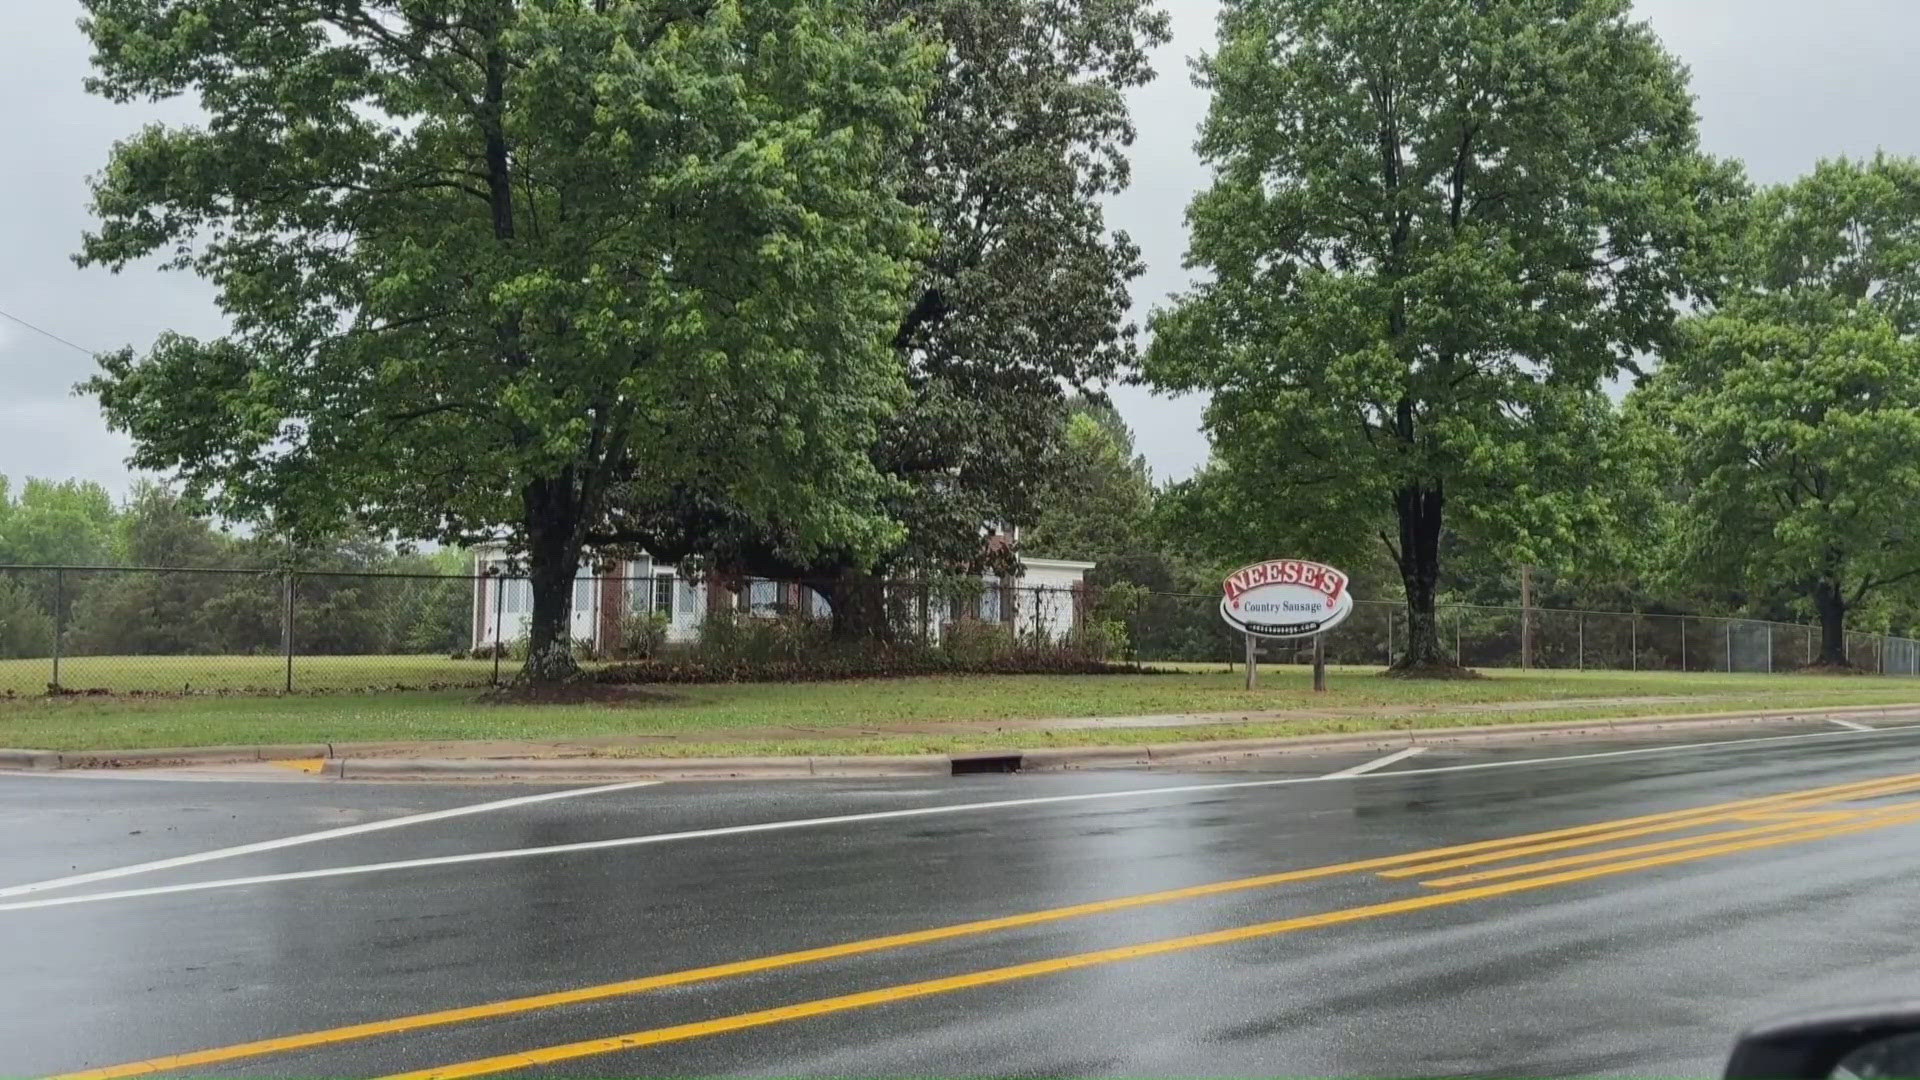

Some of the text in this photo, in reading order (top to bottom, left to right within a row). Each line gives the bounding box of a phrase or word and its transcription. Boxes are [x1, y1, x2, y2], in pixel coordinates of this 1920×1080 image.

[1228, 561, 1338, 596] NEESE'S
[1244, 600, 1322, 614] Country Sausage
